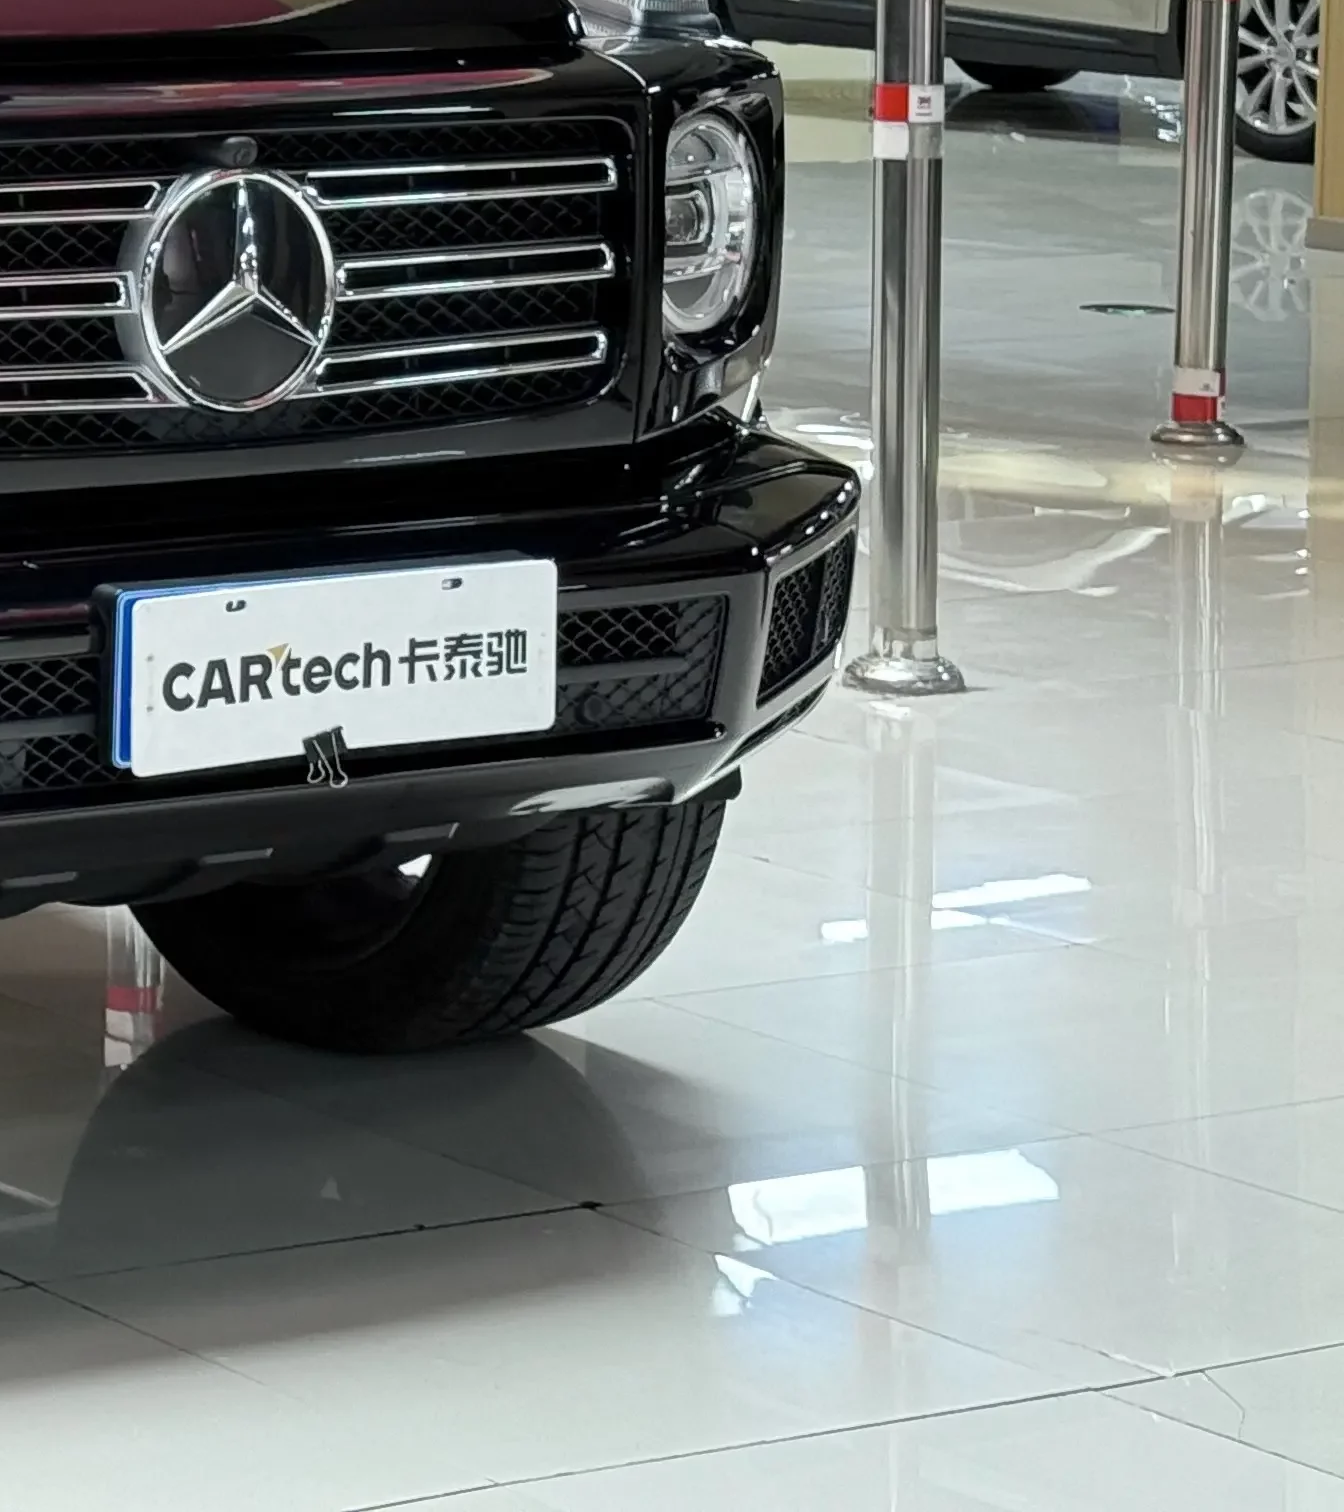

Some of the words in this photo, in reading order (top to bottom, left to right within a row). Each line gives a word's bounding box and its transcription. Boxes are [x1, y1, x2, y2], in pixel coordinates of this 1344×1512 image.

[162, 641, 392, 712] CARtech
[398, 628, 528, 686] 卡泰驰
